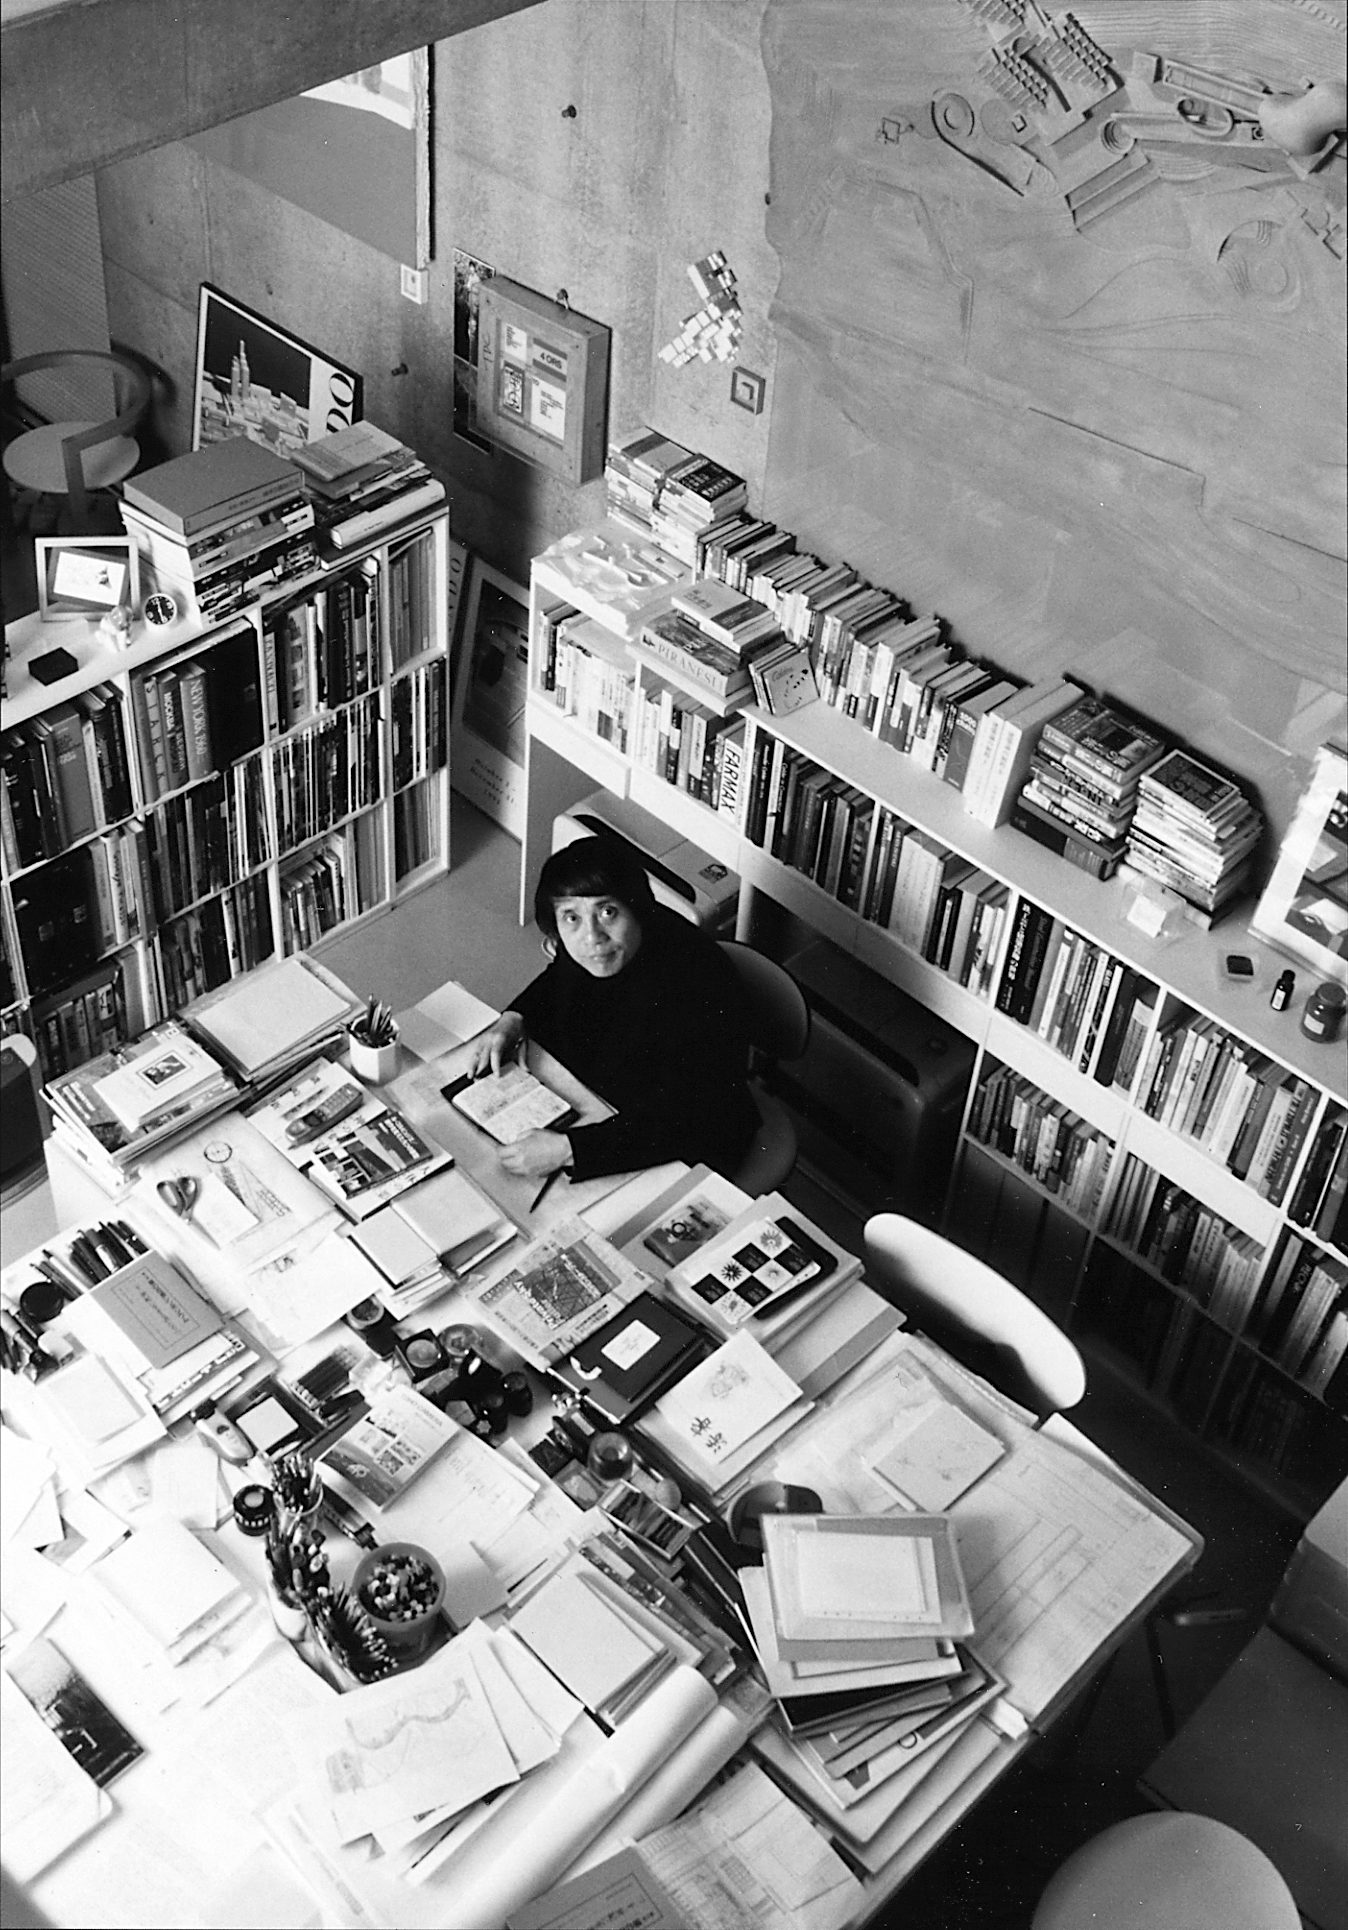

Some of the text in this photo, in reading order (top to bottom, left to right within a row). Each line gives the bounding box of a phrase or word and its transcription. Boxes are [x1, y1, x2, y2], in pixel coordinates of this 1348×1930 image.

[658, 644, 718, 688] PIRANESI
[146, 684, 165, 780] STARCK
[164, 692, 175, 731] МОСКВА
[190, 679, 206, 755] NEW YORK 1960
[719, 744, 742, 815] FARMAX
[513, 1280, 559, 1330] Private Sky
